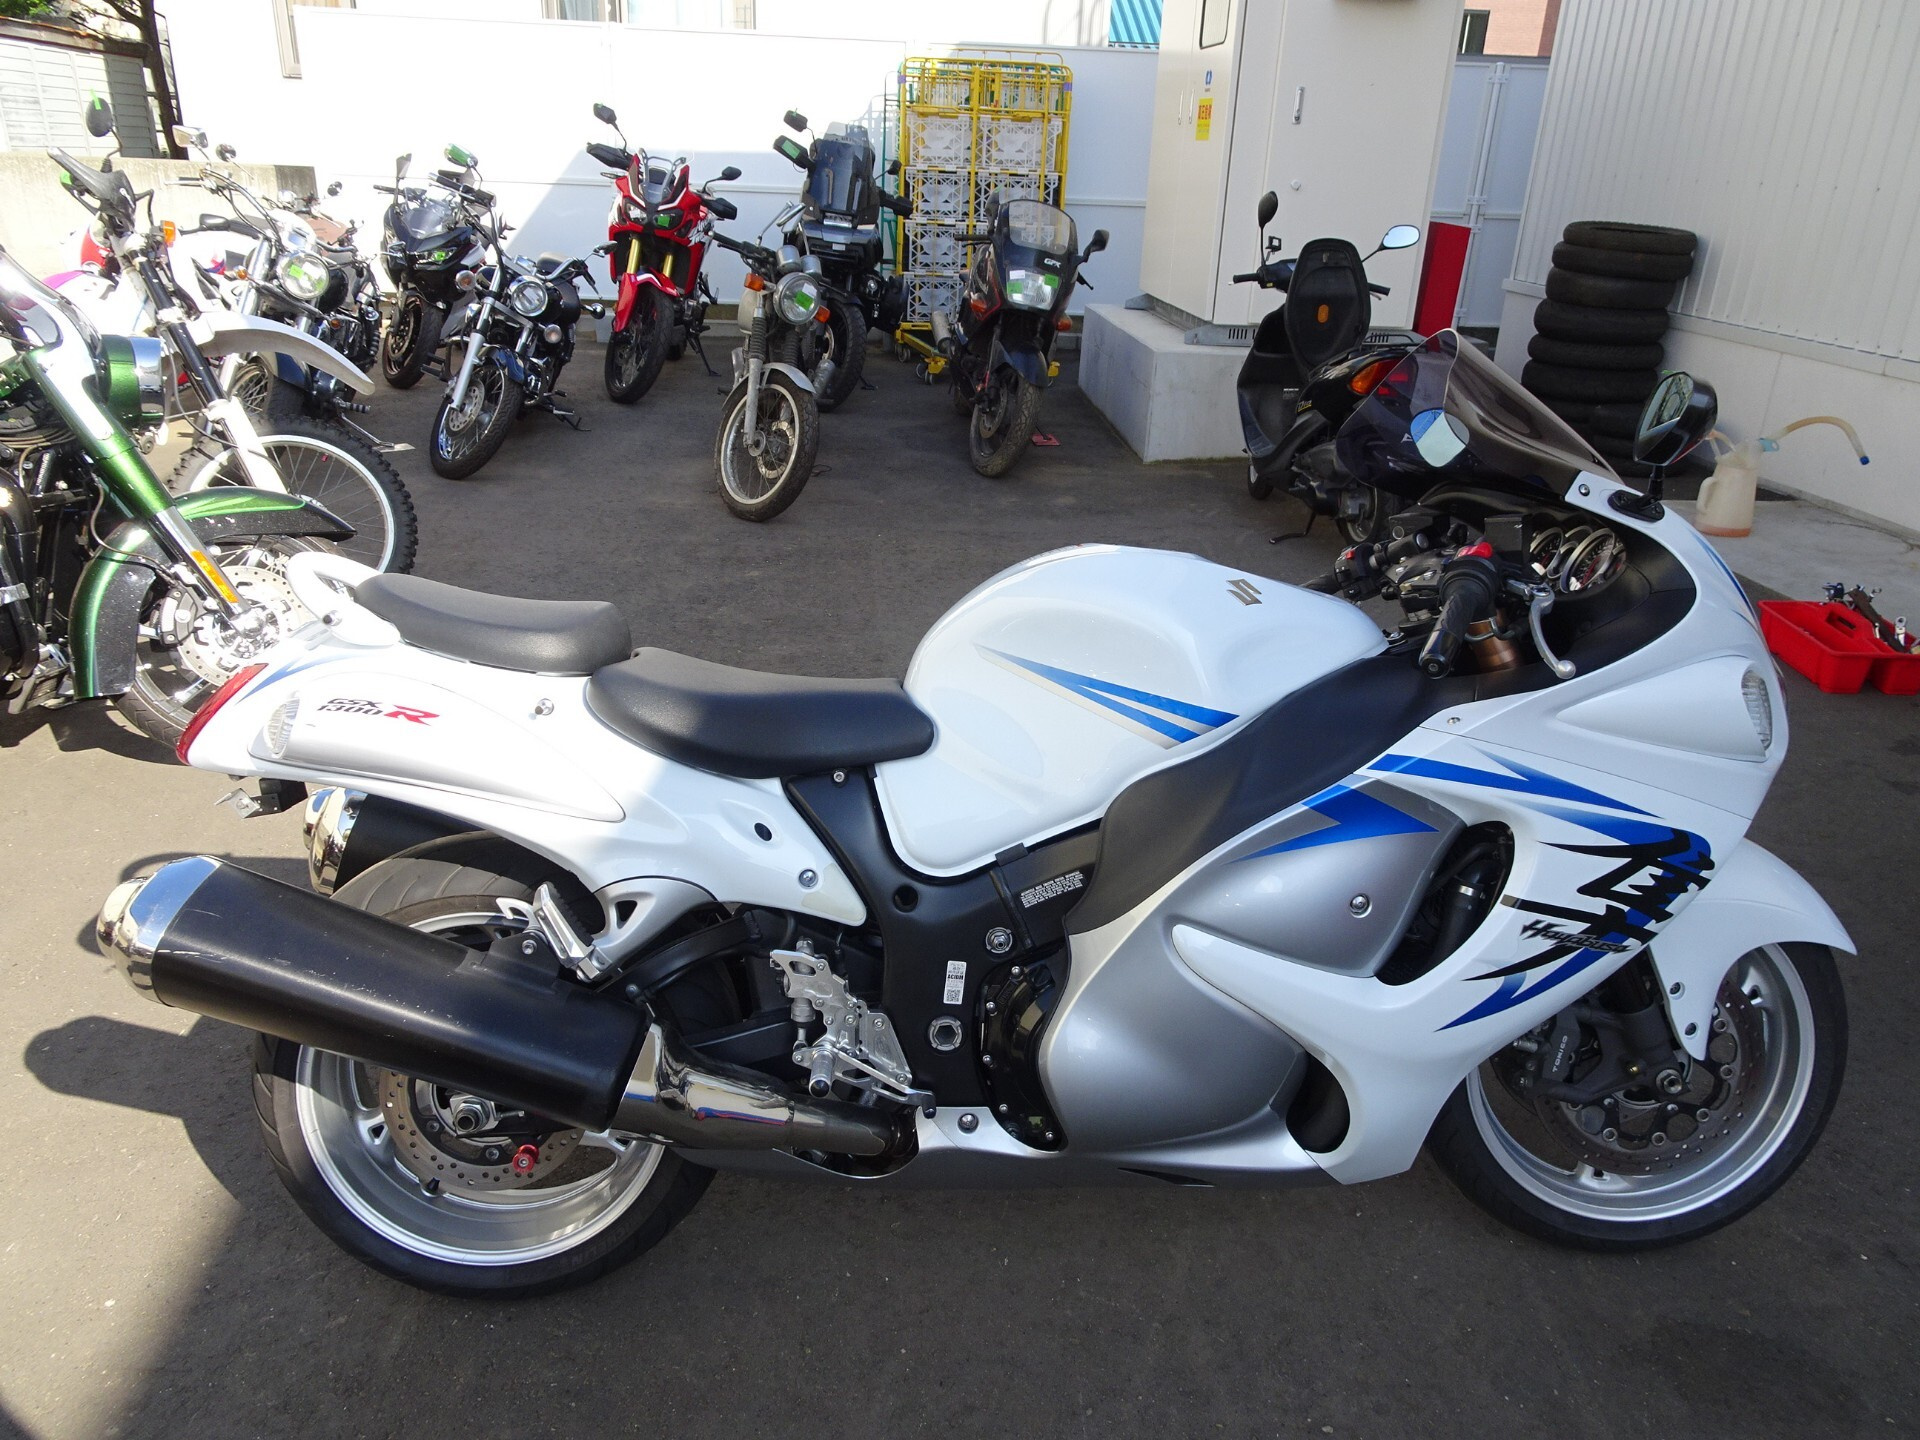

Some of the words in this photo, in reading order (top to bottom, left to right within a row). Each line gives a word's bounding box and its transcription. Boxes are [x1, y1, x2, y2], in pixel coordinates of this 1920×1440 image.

[317, 704, 383, 715] 1300
[383, 704, 440, 726] R
[1519, 918, 1633, 954] Hayabusa
